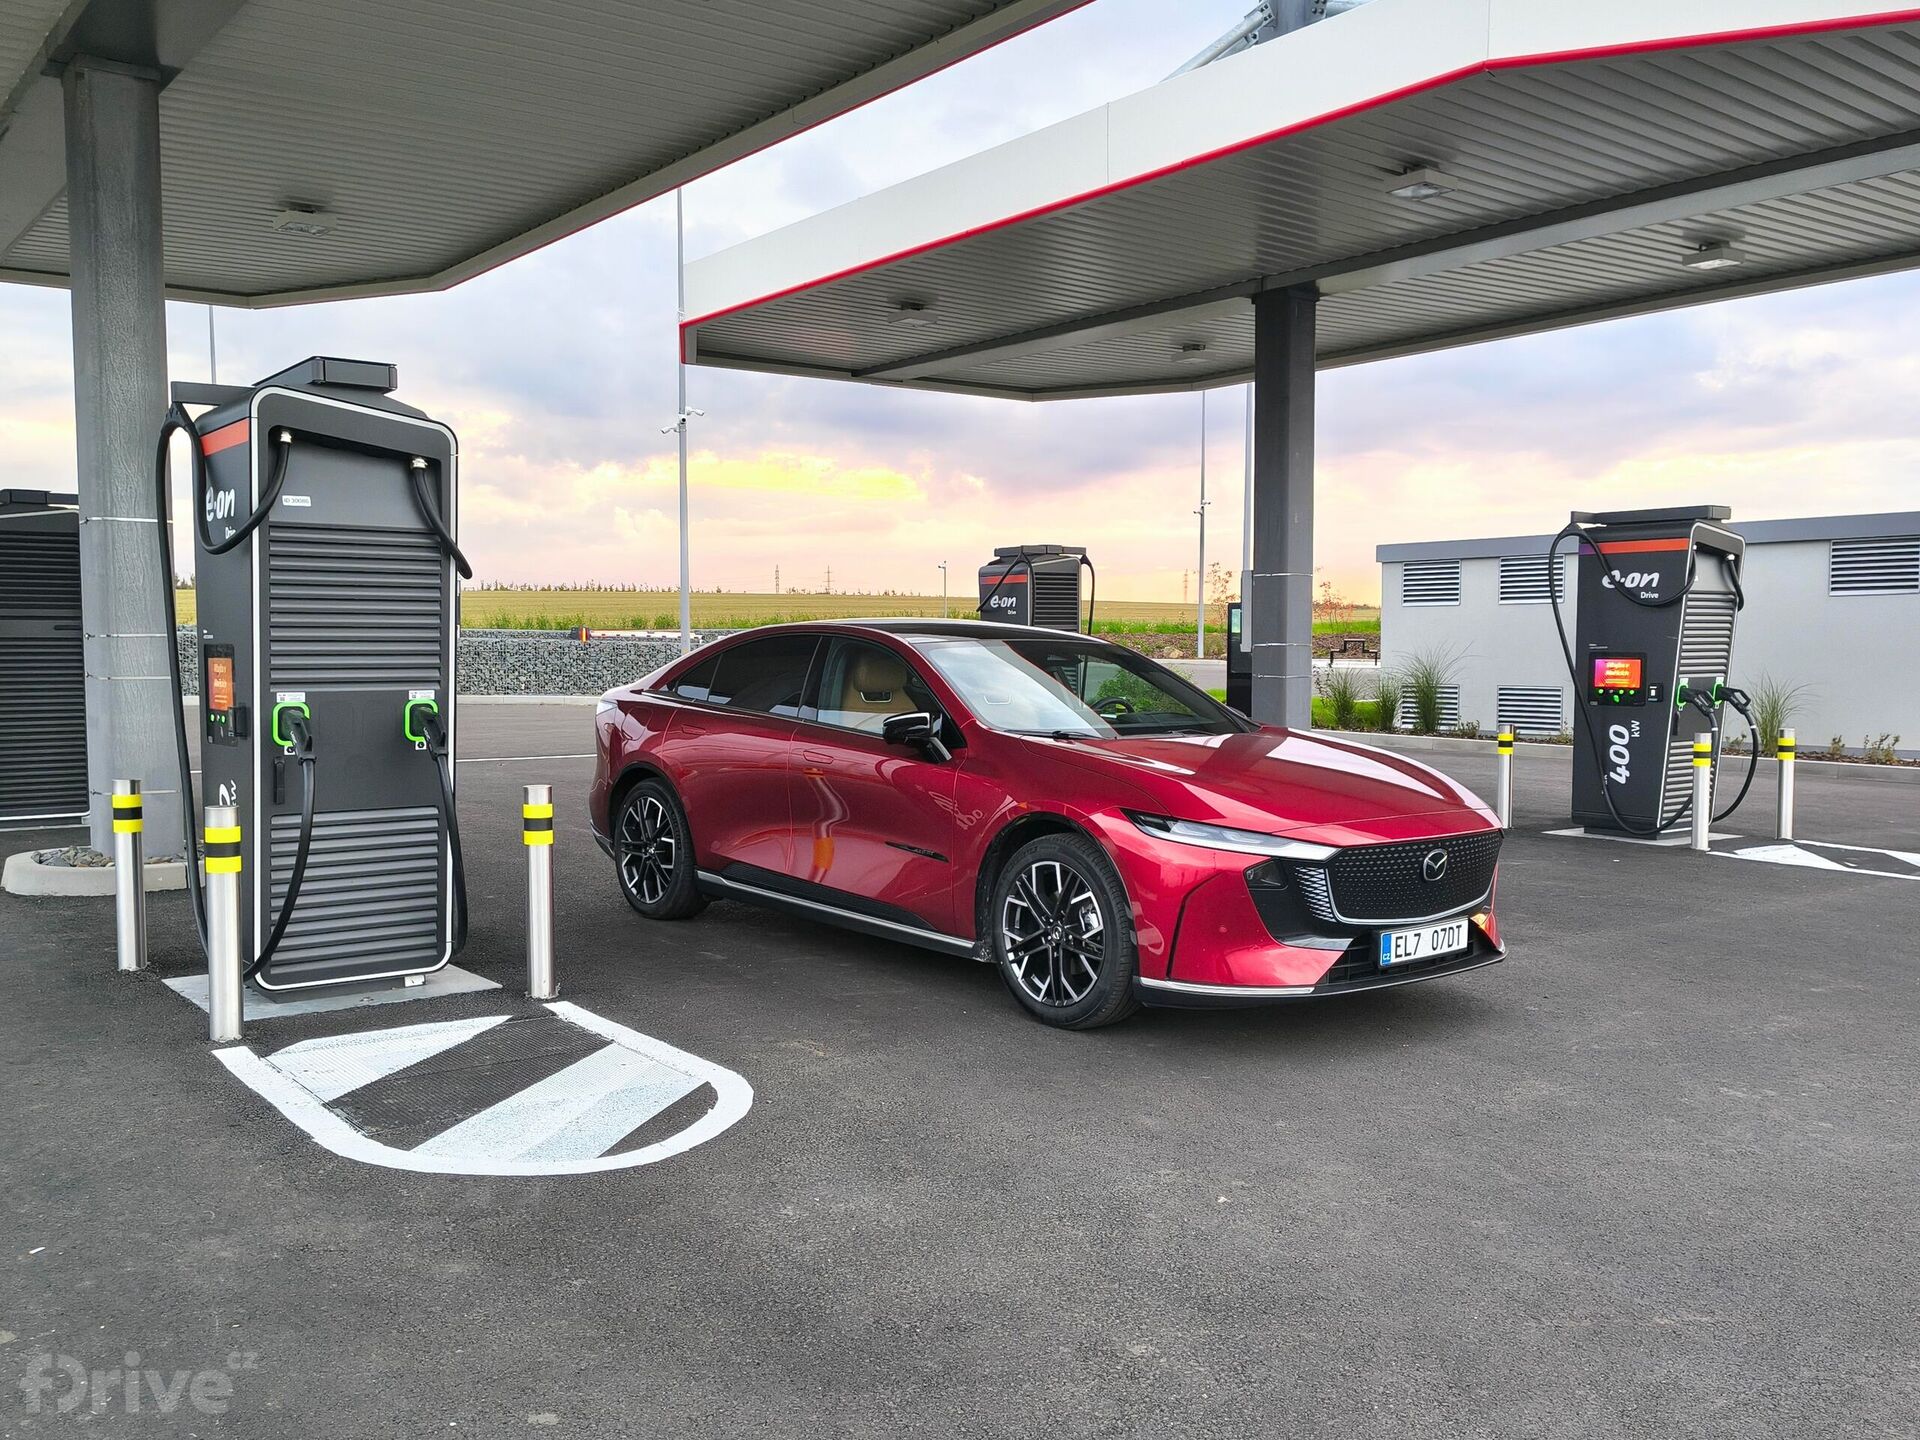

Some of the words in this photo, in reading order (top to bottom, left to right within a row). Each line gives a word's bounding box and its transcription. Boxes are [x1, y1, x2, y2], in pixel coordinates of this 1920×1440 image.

[1640, 591, 1659, 599] Drive
[1609, 724, 1631, 784] 400
[1631, 720, 1641, 738] kW
[1395, 932, 1421, 959] EL7
[1432, 924, 1462, 951] 07DT
